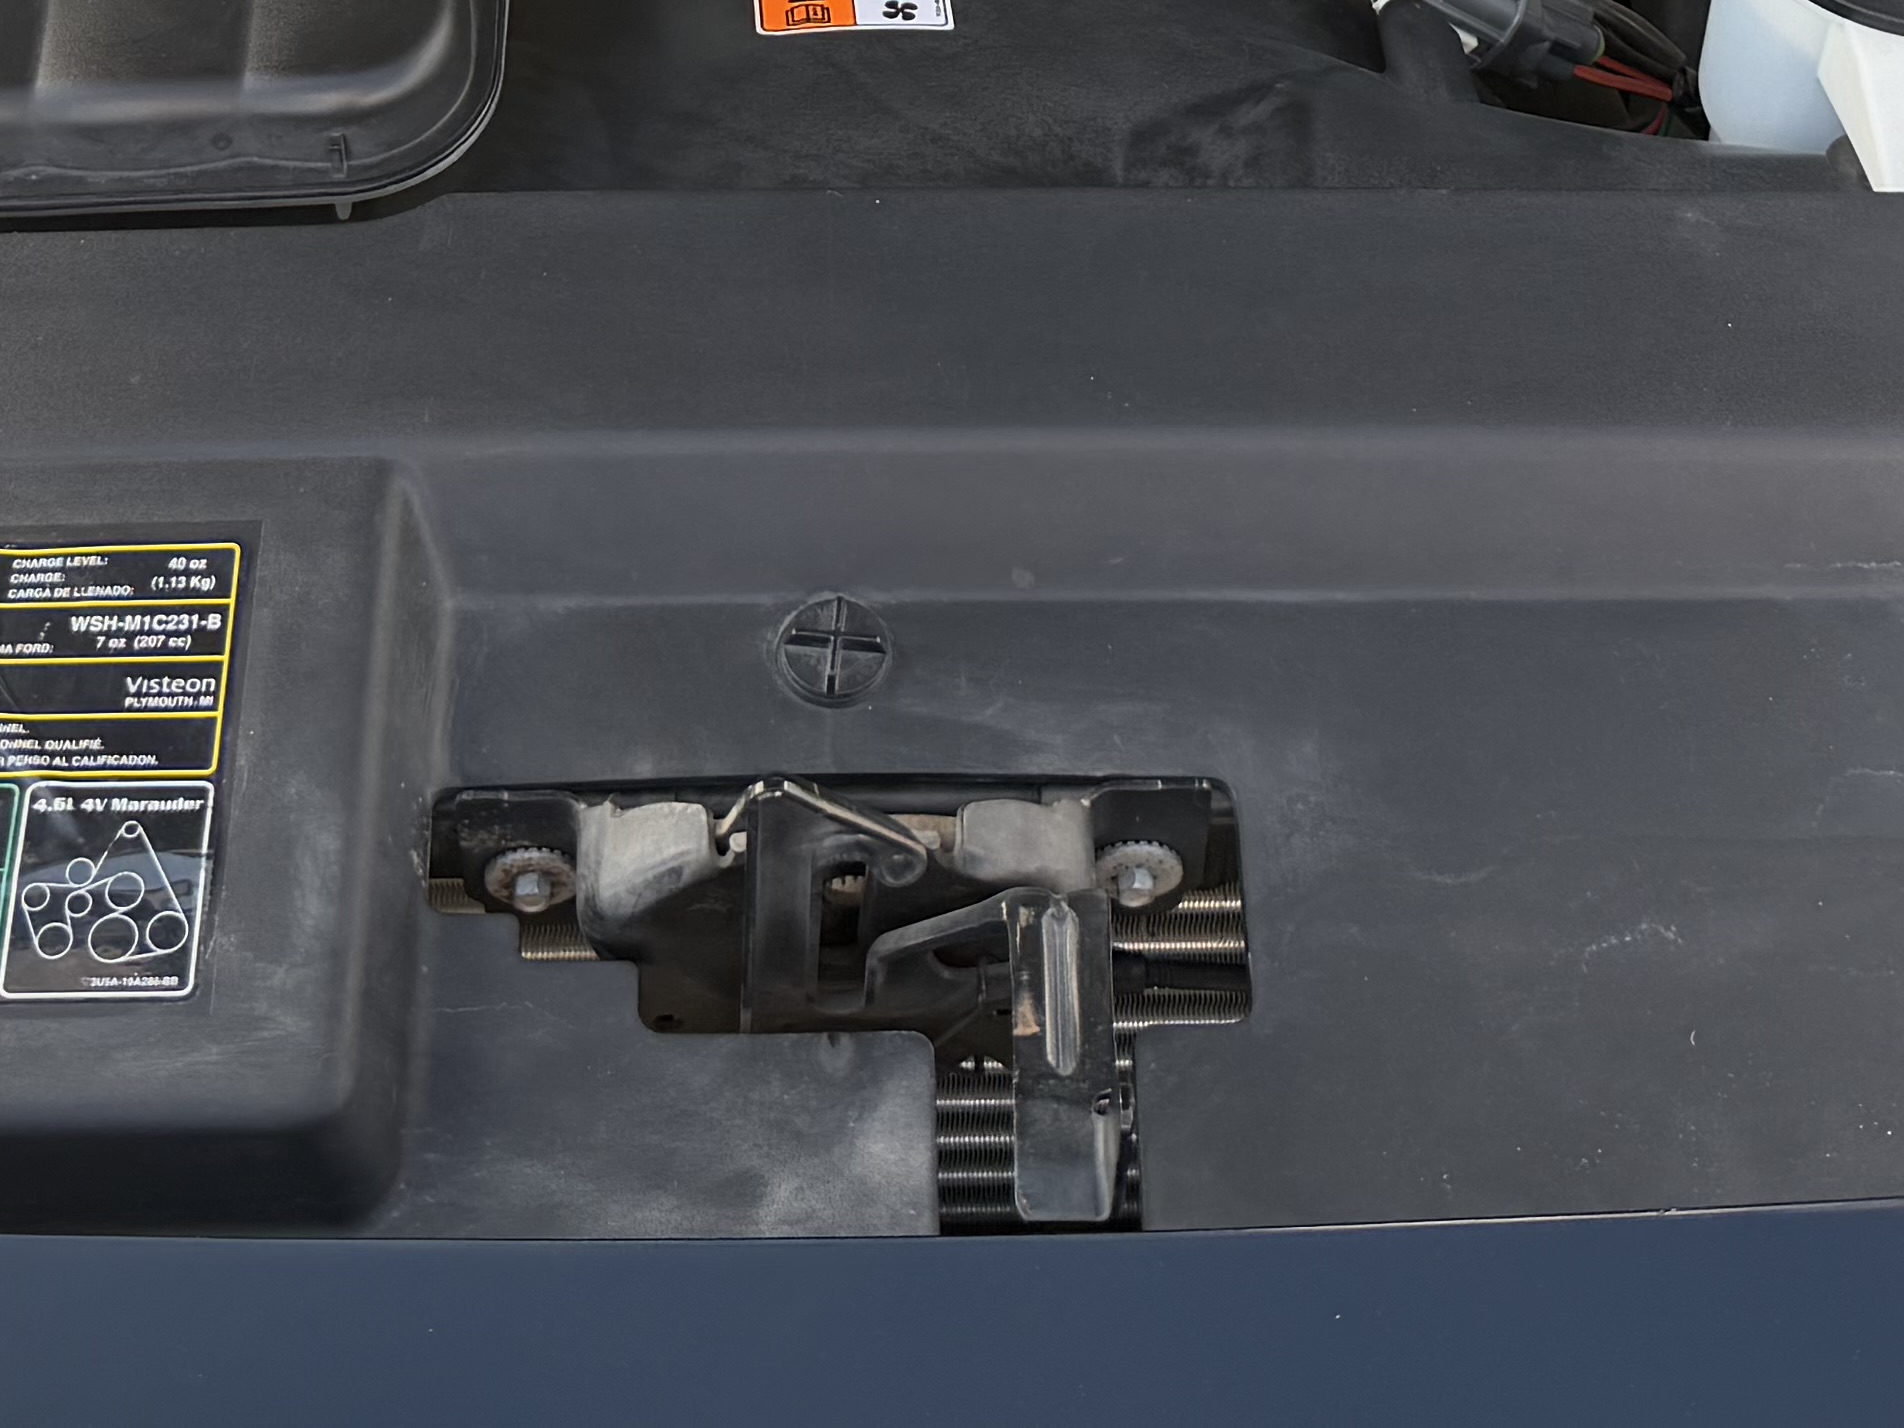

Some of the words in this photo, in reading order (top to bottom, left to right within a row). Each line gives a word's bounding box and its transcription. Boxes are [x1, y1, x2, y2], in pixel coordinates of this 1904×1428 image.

[12, 557, 64, 568] CHARGE
[66, 556, 108, 567] LEVEL:
[168, 557, 187, 569] 40
[190, 558, 208, 569] oz
[10, 572, 65, 583] CHARGE:
[151, 576, 187, 590] (1.13
[190, 575, 216, 590] Kg)
[53, 587, 71, 597] DE
[71, 614, 221, 631] WSH-M1C231-B
[15, 643, 54, 653] FORD:
[96, 637, 106, 649] 7
[108, 638, 127, 648] oz
[133, 635, 167, 651] (207
[169, 635, 192, 651] cc)
[125, 676, 216, 694] Visteon
[32, 798, 76, 812] 4.6L
[80, 798, 108, 812] 4V
[110, 797, 204, 812] Marauder
